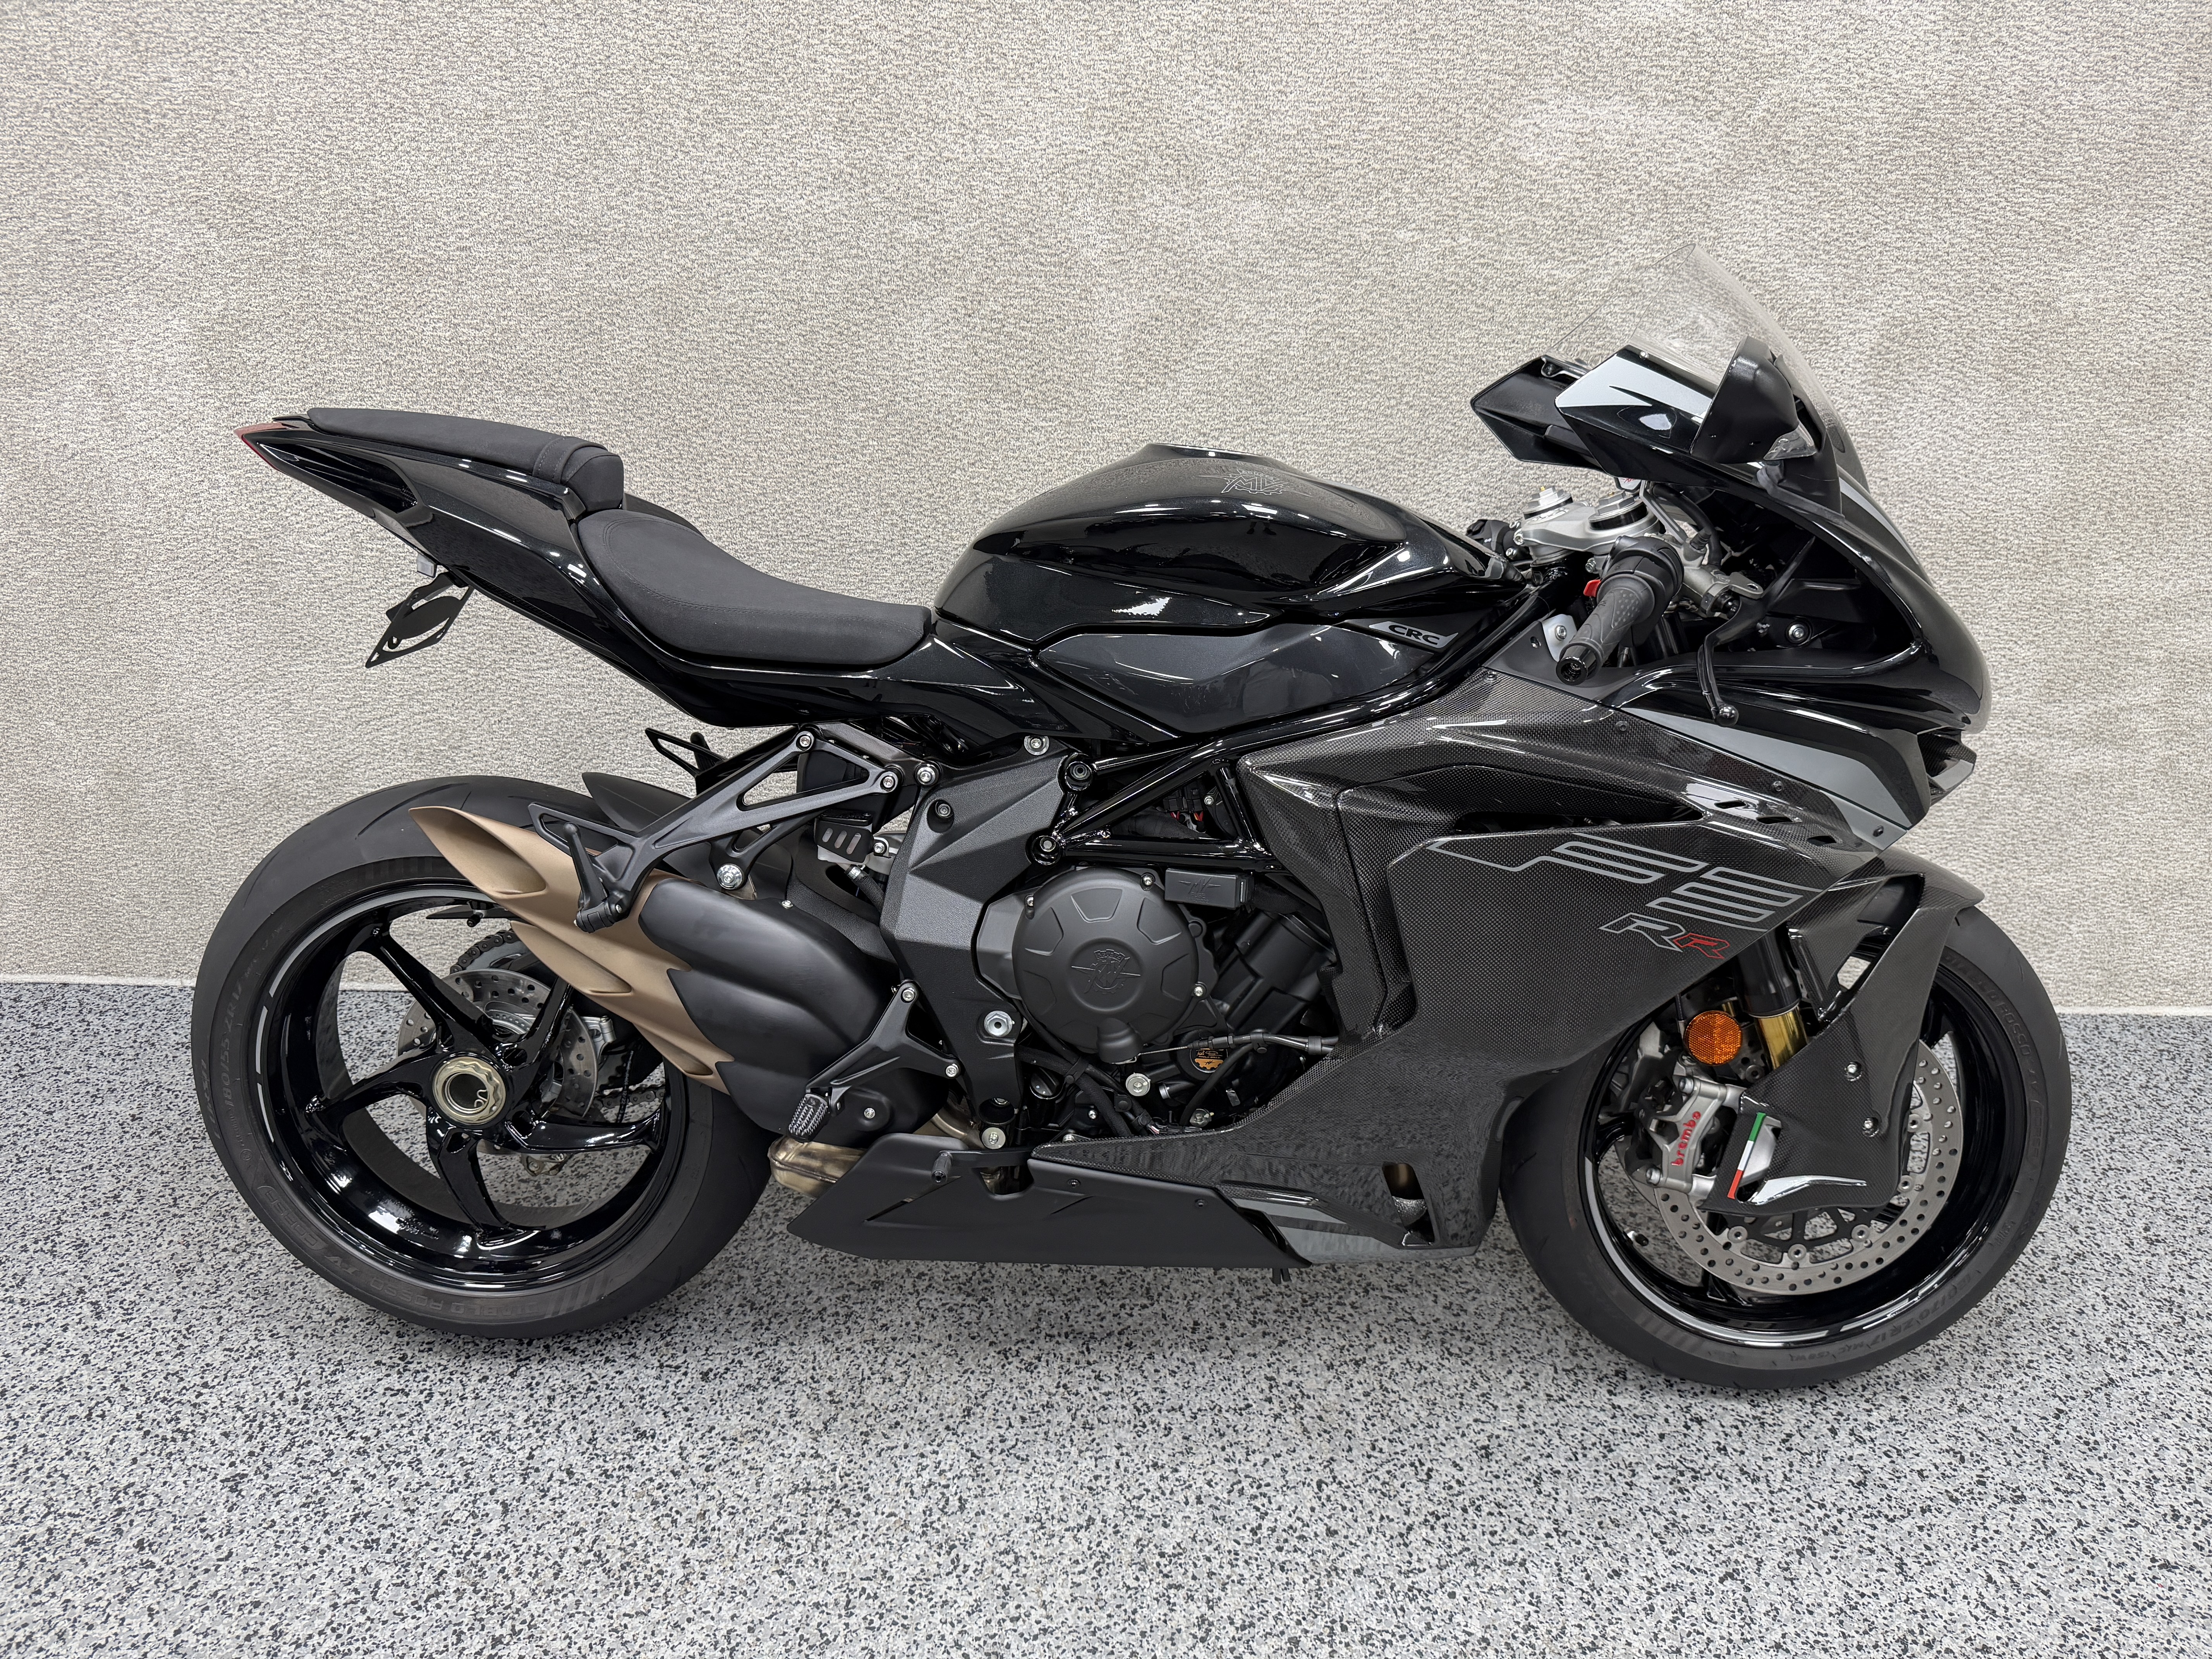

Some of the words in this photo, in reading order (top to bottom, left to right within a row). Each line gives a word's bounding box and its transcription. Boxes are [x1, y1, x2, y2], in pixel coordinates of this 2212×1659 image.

[1388, 624, 1440, 645] CRC
[1599, 912, 1730, 960] RR
[221, 1036, 234, 1106] 180/55
[1670, 1111, 1701, 1166] brembo
[264, 1190, 318, 1247] CORSA
[324, 1253, 360, 1274] IV
[369, 1276, 443, 1310] ROSSO
